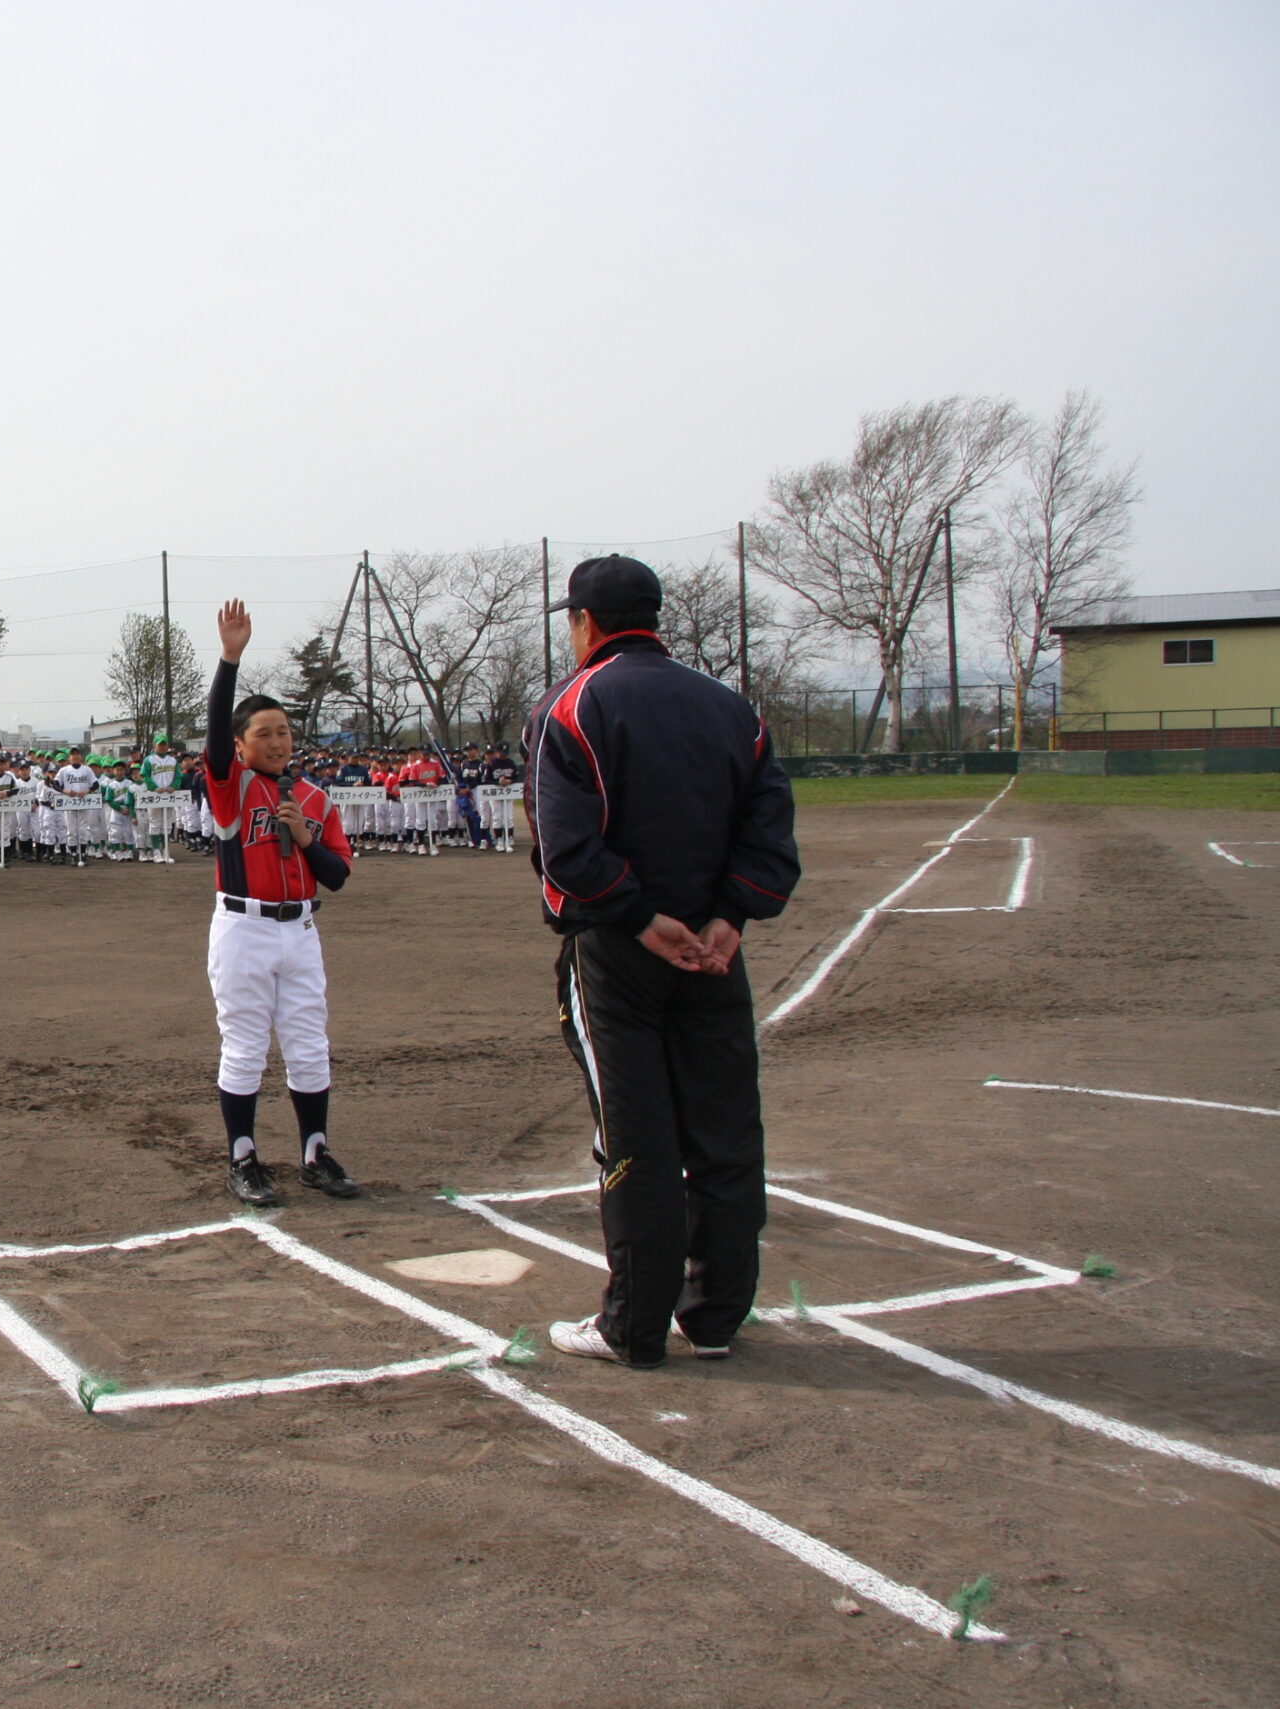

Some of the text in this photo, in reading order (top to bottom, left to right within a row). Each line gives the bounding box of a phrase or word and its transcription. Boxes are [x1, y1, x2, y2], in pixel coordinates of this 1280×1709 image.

[140, 793, 190, 804] 大栄クーガーズ
